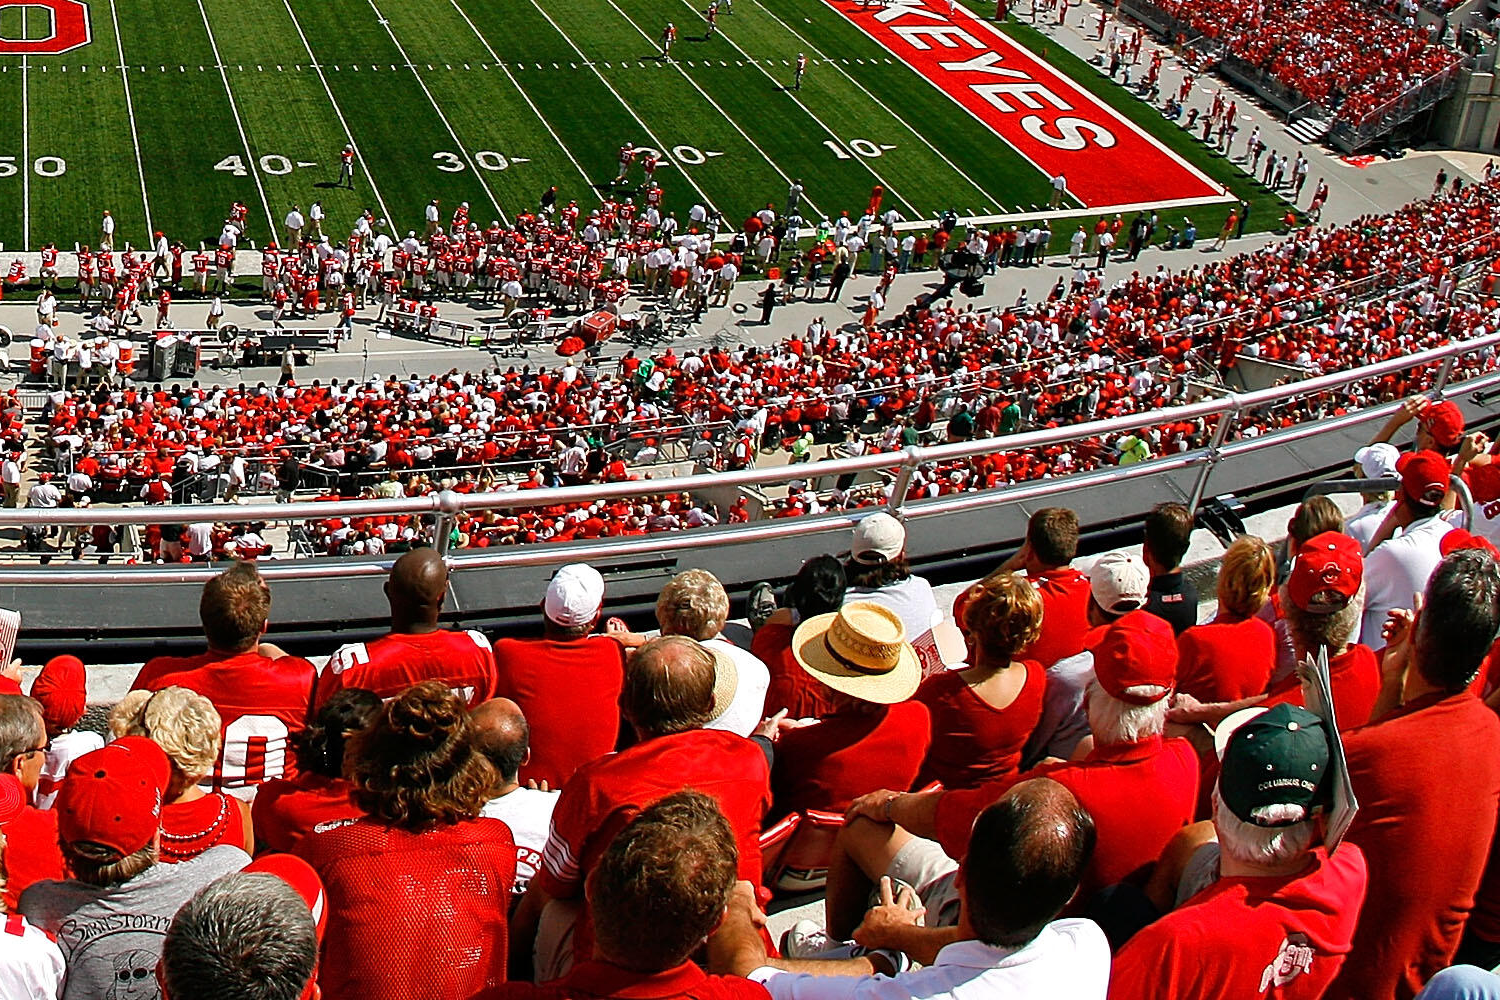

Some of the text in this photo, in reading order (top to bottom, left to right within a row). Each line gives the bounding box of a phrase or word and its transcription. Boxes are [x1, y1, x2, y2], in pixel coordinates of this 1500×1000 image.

[822, 138, 884, 160] 10
[213, 154, 297, 177] 40
[431, 150, 510, 173] 30
[69, 406, 77, 416] 5
